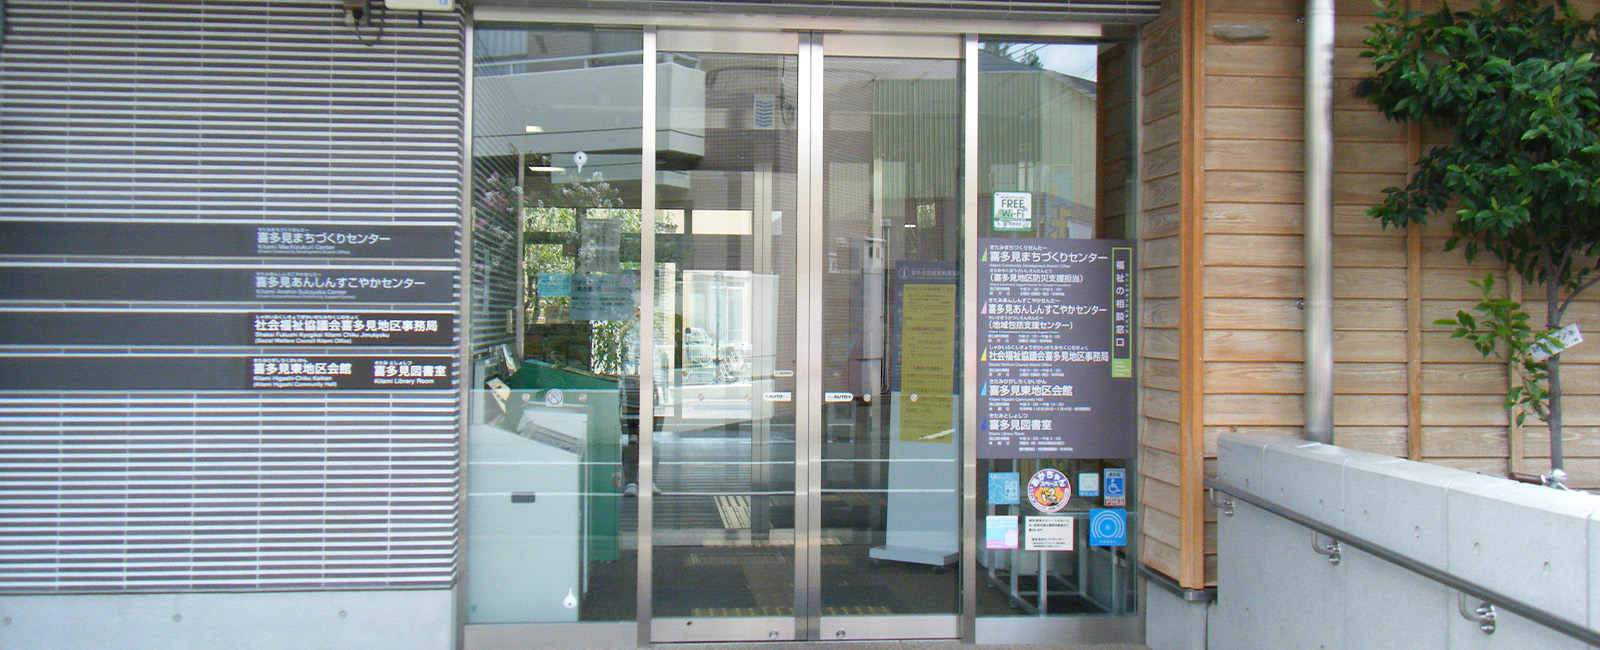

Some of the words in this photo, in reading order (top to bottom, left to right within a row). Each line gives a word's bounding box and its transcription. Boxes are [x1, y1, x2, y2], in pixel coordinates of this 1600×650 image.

[1001, 199, 1025, 208] FREE
[1001, 208, 1025, 218] Wi-Fi
[257, 231, 391, 244] 喜多見まちづくりセンター
[989, 251, 1108, 263] 喜多見まちづくりセンター
[255, 276, 426, 289] 喜多見あんしんすこやかセンター
[988, 303, 1108, 315] 喜多見あんしんすこやかセンター
[1116, 260, 1125, 347] 福祉の相談窓口
[254, 319, 438, 332] 社会福祉協議会喜多見地区事務局
[988, 350, 1109, 362] 社会福祉協議会喜多見地区事務局
[252, 363, 352, 375] 喜多見東地区会館
[373, 365, 447, 377] 喜多見図書室
[988, 385, 1073, 396] 喜多見東地区会館
[988, 419, 1052, 430] 喜多見図書室
[1030, 470, 1068, 488] あかちゃん
